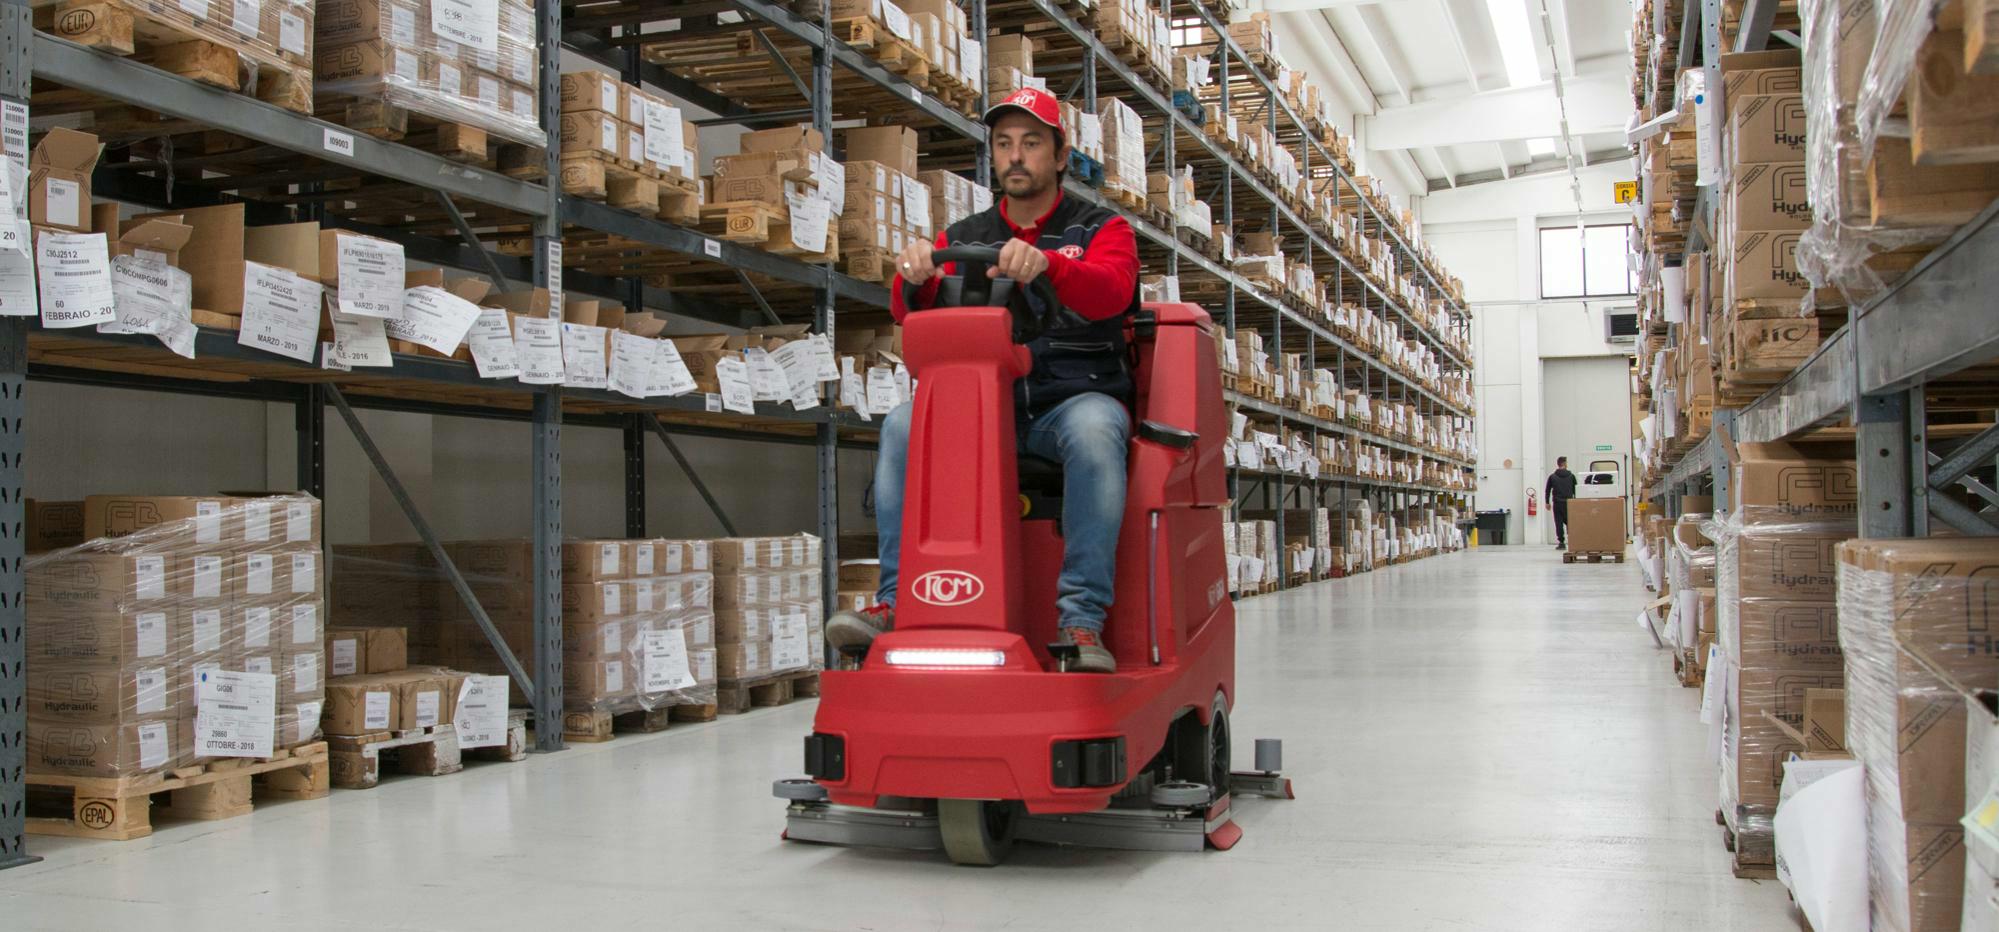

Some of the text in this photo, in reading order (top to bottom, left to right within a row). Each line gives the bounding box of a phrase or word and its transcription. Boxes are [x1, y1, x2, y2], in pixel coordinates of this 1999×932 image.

[46, 310, 91, 320] FEBBRAIO
[257, 334, 280, 346] MARZO
[207, 741, 236, 750] OTTOBRE
[42, 756, 96, 769] Hydraulic
[86, 807, 109, 823] EPAL
